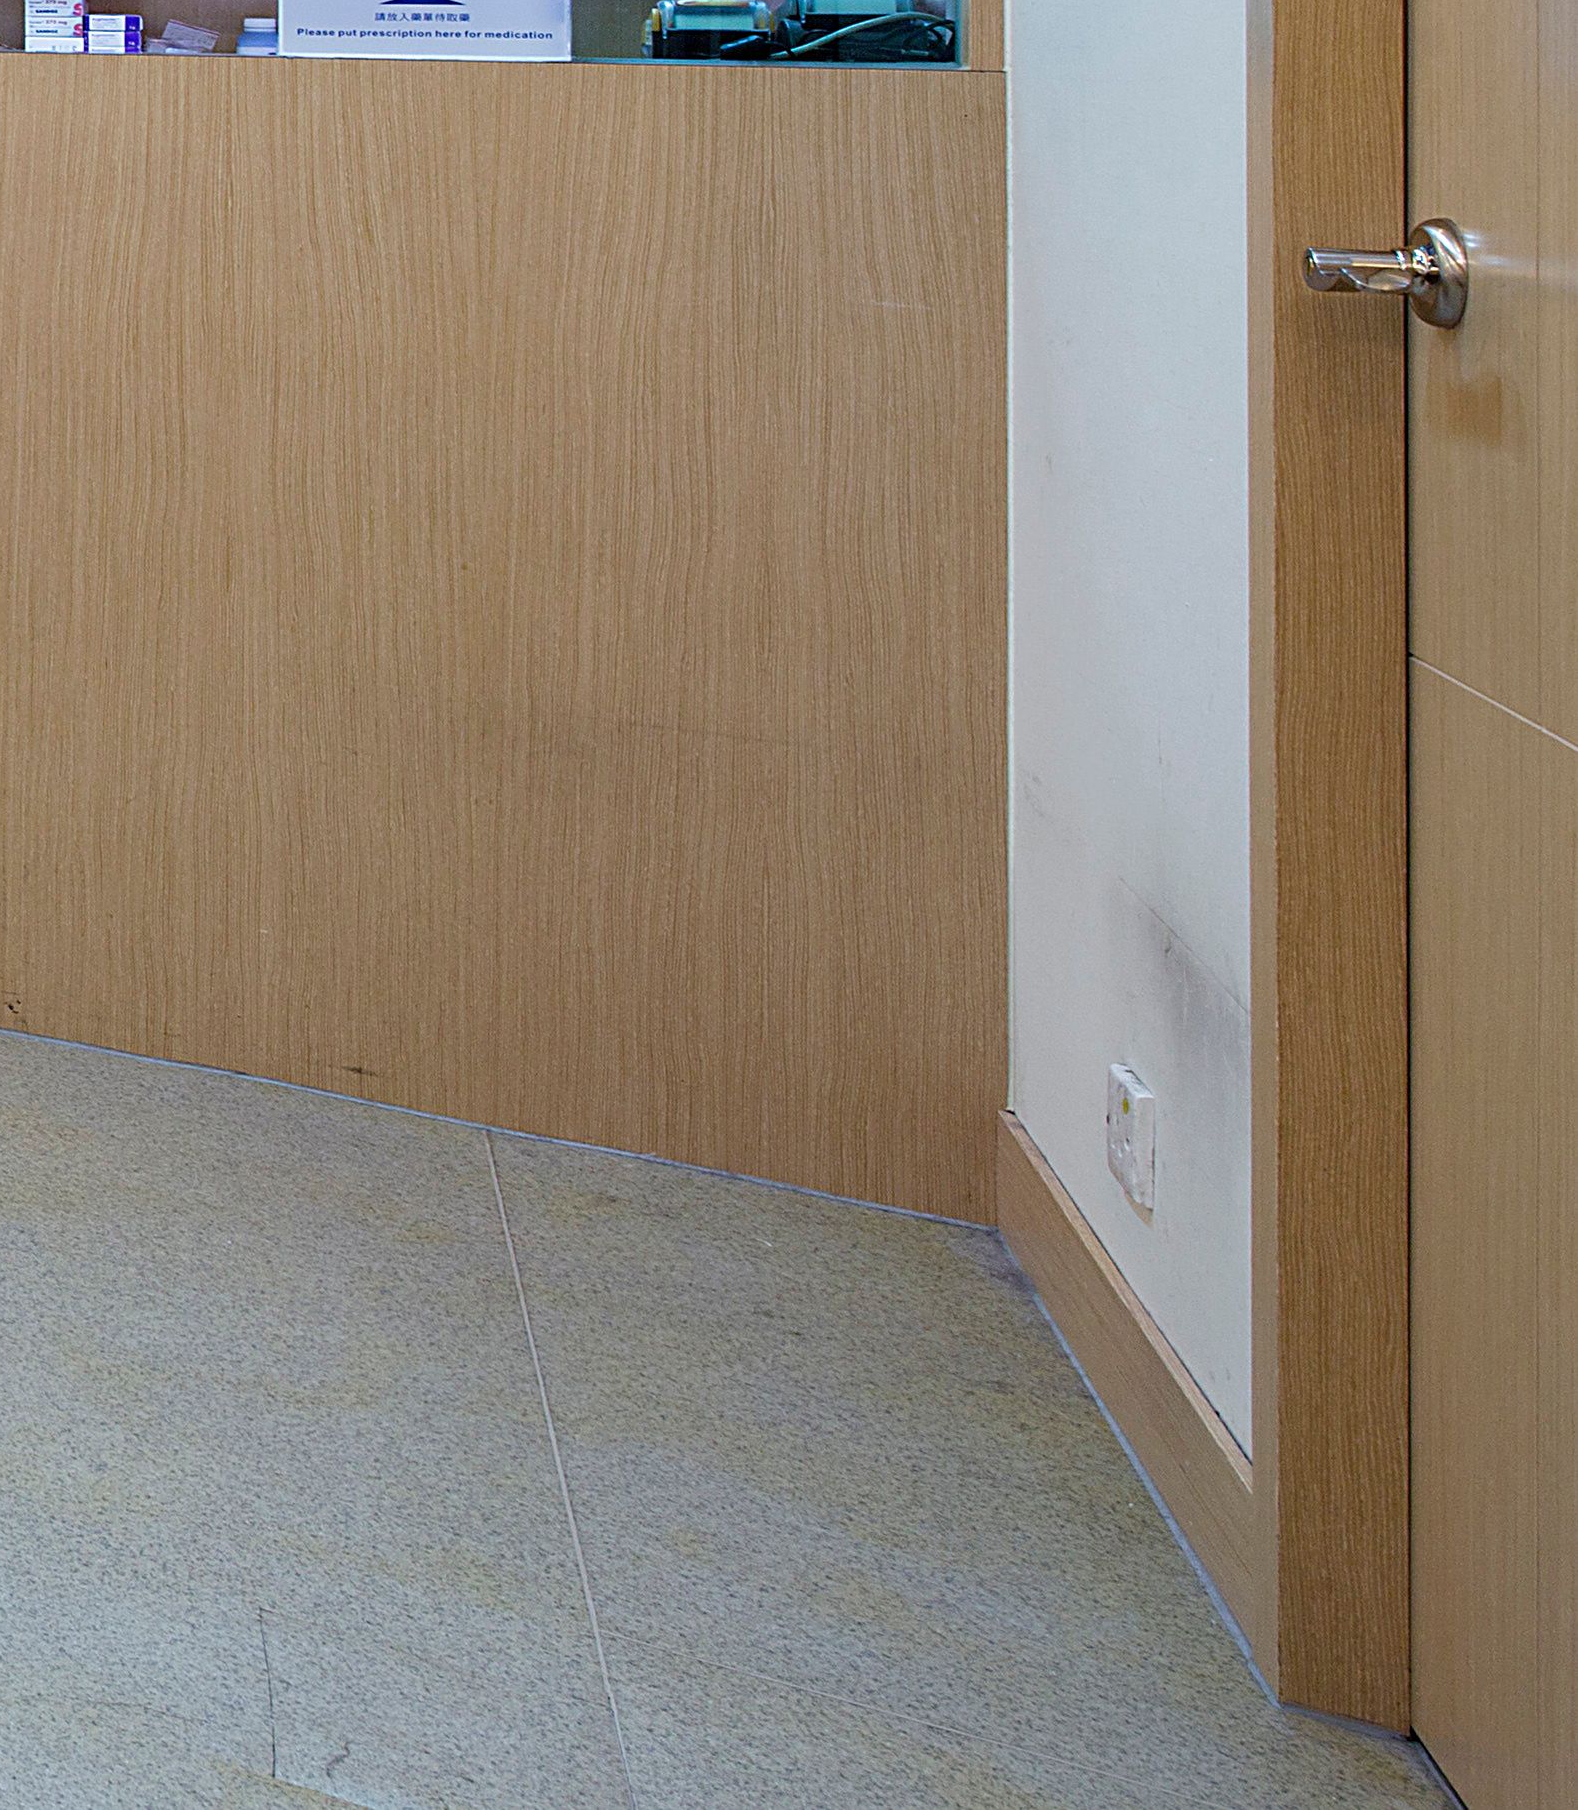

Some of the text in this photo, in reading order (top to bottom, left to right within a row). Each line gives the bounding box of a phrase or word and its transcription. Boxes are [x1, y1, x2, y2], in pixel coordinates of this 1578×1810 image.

[296, 28, 553, 40] Please put prescription here for medication
